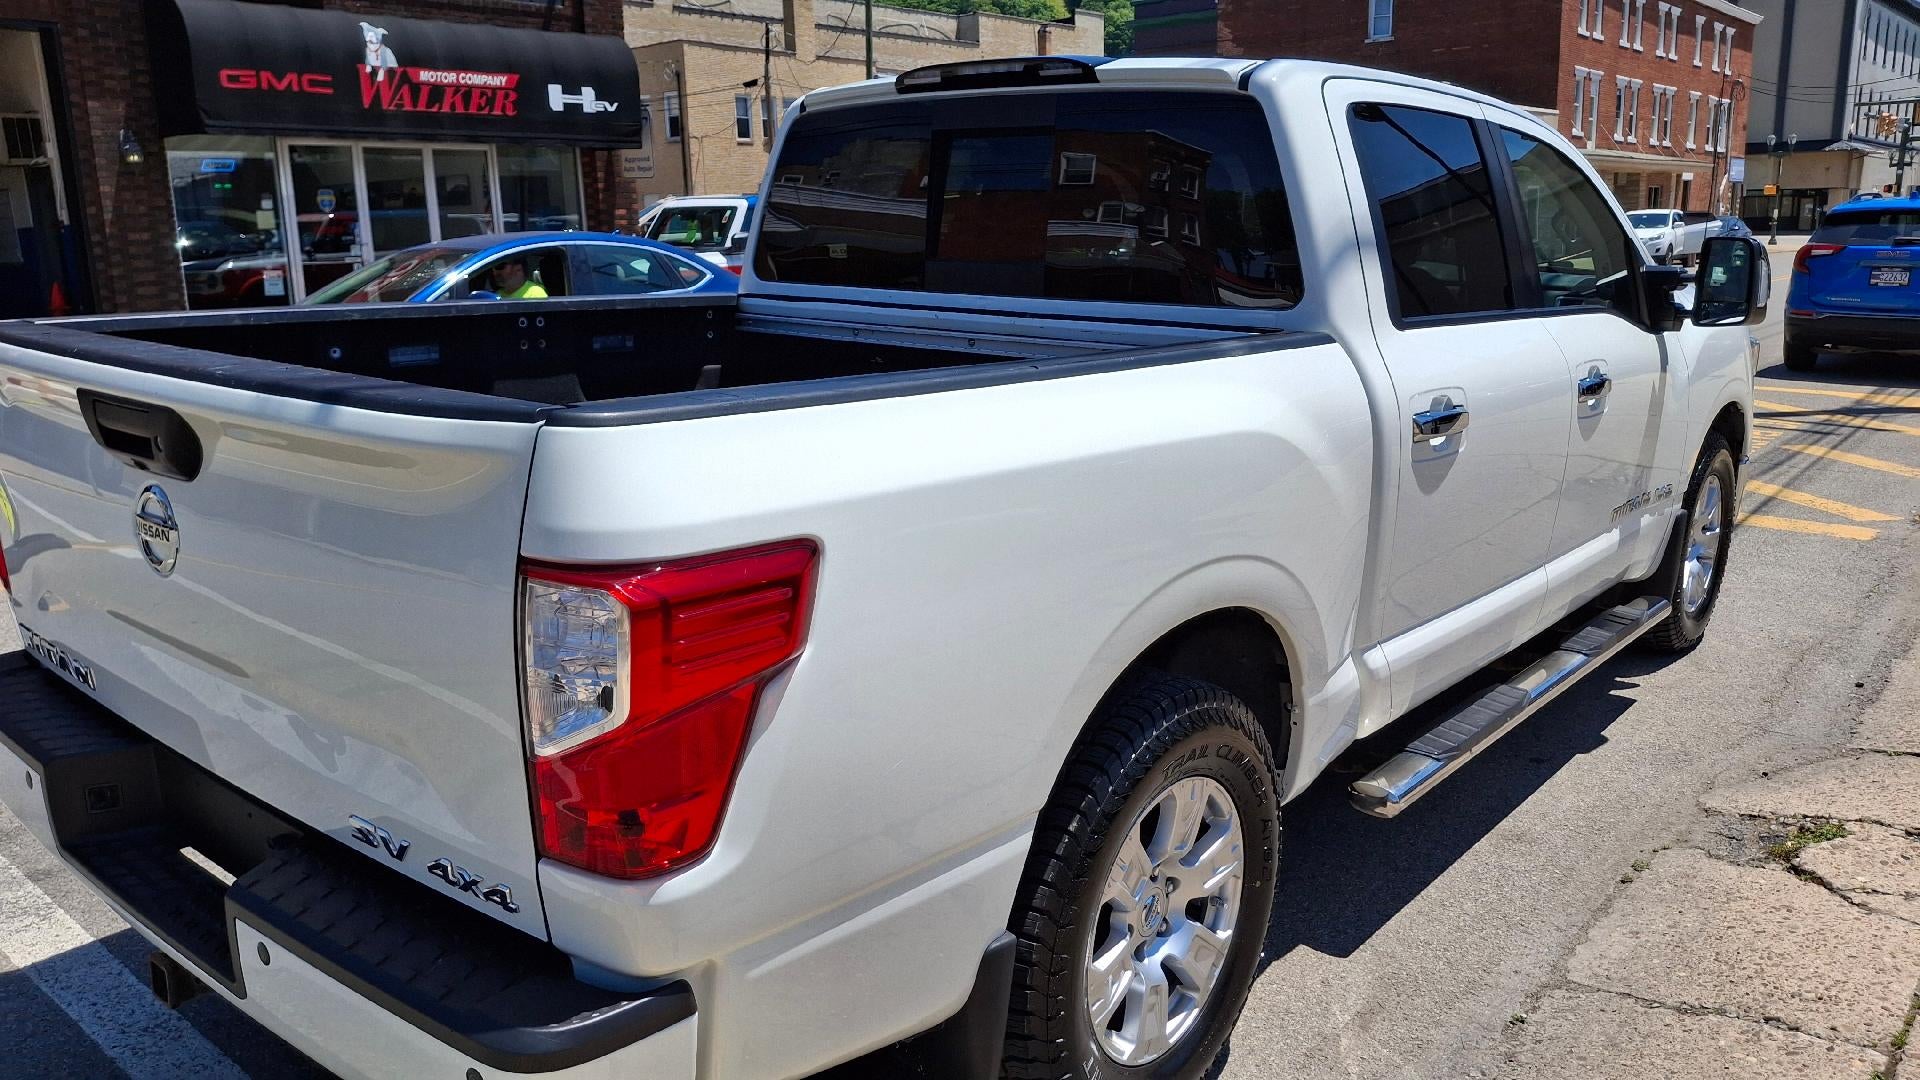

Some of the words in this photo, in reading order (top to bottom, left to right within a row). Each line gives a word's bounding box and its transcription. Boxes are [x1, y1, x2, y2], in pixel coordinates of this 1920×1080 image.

[219, 68, 334, 95] GMC
[357, 64, 518, 116] WALKER
[419, 70, 457, 83] MOTOR
[458, 73, 508, 86] COMPANY
[137, 522, 171, 543] NISSAN
[349, 814, 411, 862] SV
